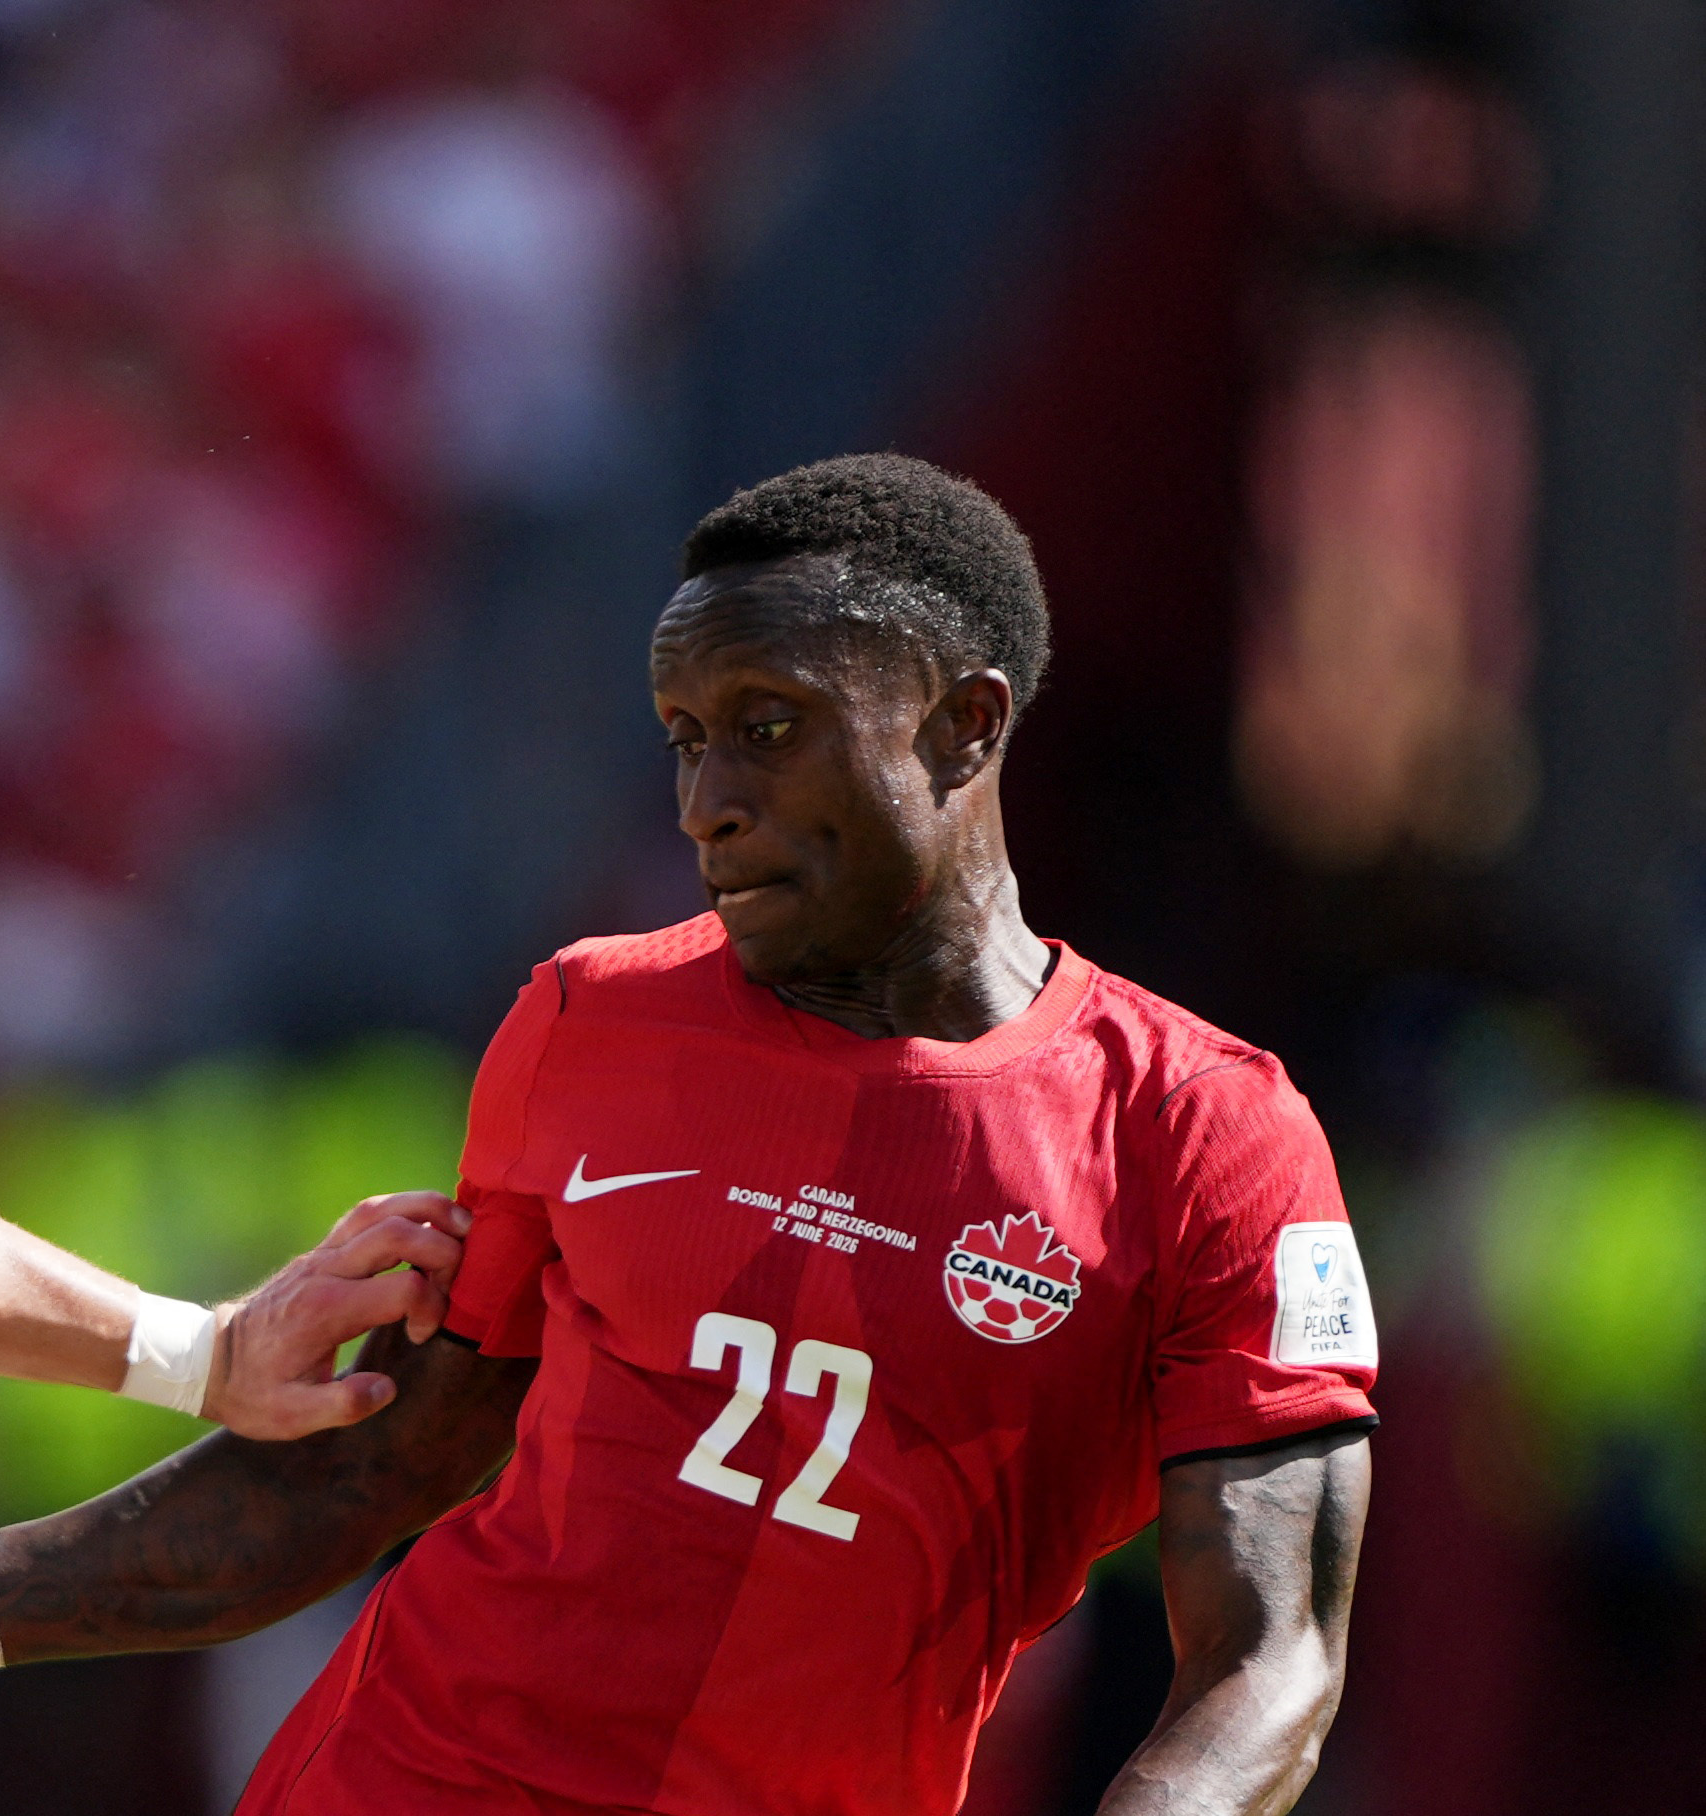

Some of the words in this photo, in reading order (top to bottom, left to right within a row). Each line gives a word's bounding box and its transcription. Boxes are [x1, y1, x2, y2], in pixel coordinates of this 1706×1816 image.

[798, 1184, 855, 1211] CANADA
[727, 1186, 782, 1212] BOSNIA
[787, 1200, 818, 1220] AND
[819, 1209, 917, 1251] HERZEGOVINA
[771, 1215, 788, 1232] 12
[789, 1221, 824, 1243] JUNE
[826, 1232, 860, 1254] 2026
[949, 1253, 1070, 1308] CANADA
[1303, 1313, 1353, 1339] PEACE
[1311, 1341, 1342, 1353] FIFA
[678, 1312, 874, 1541] 22
